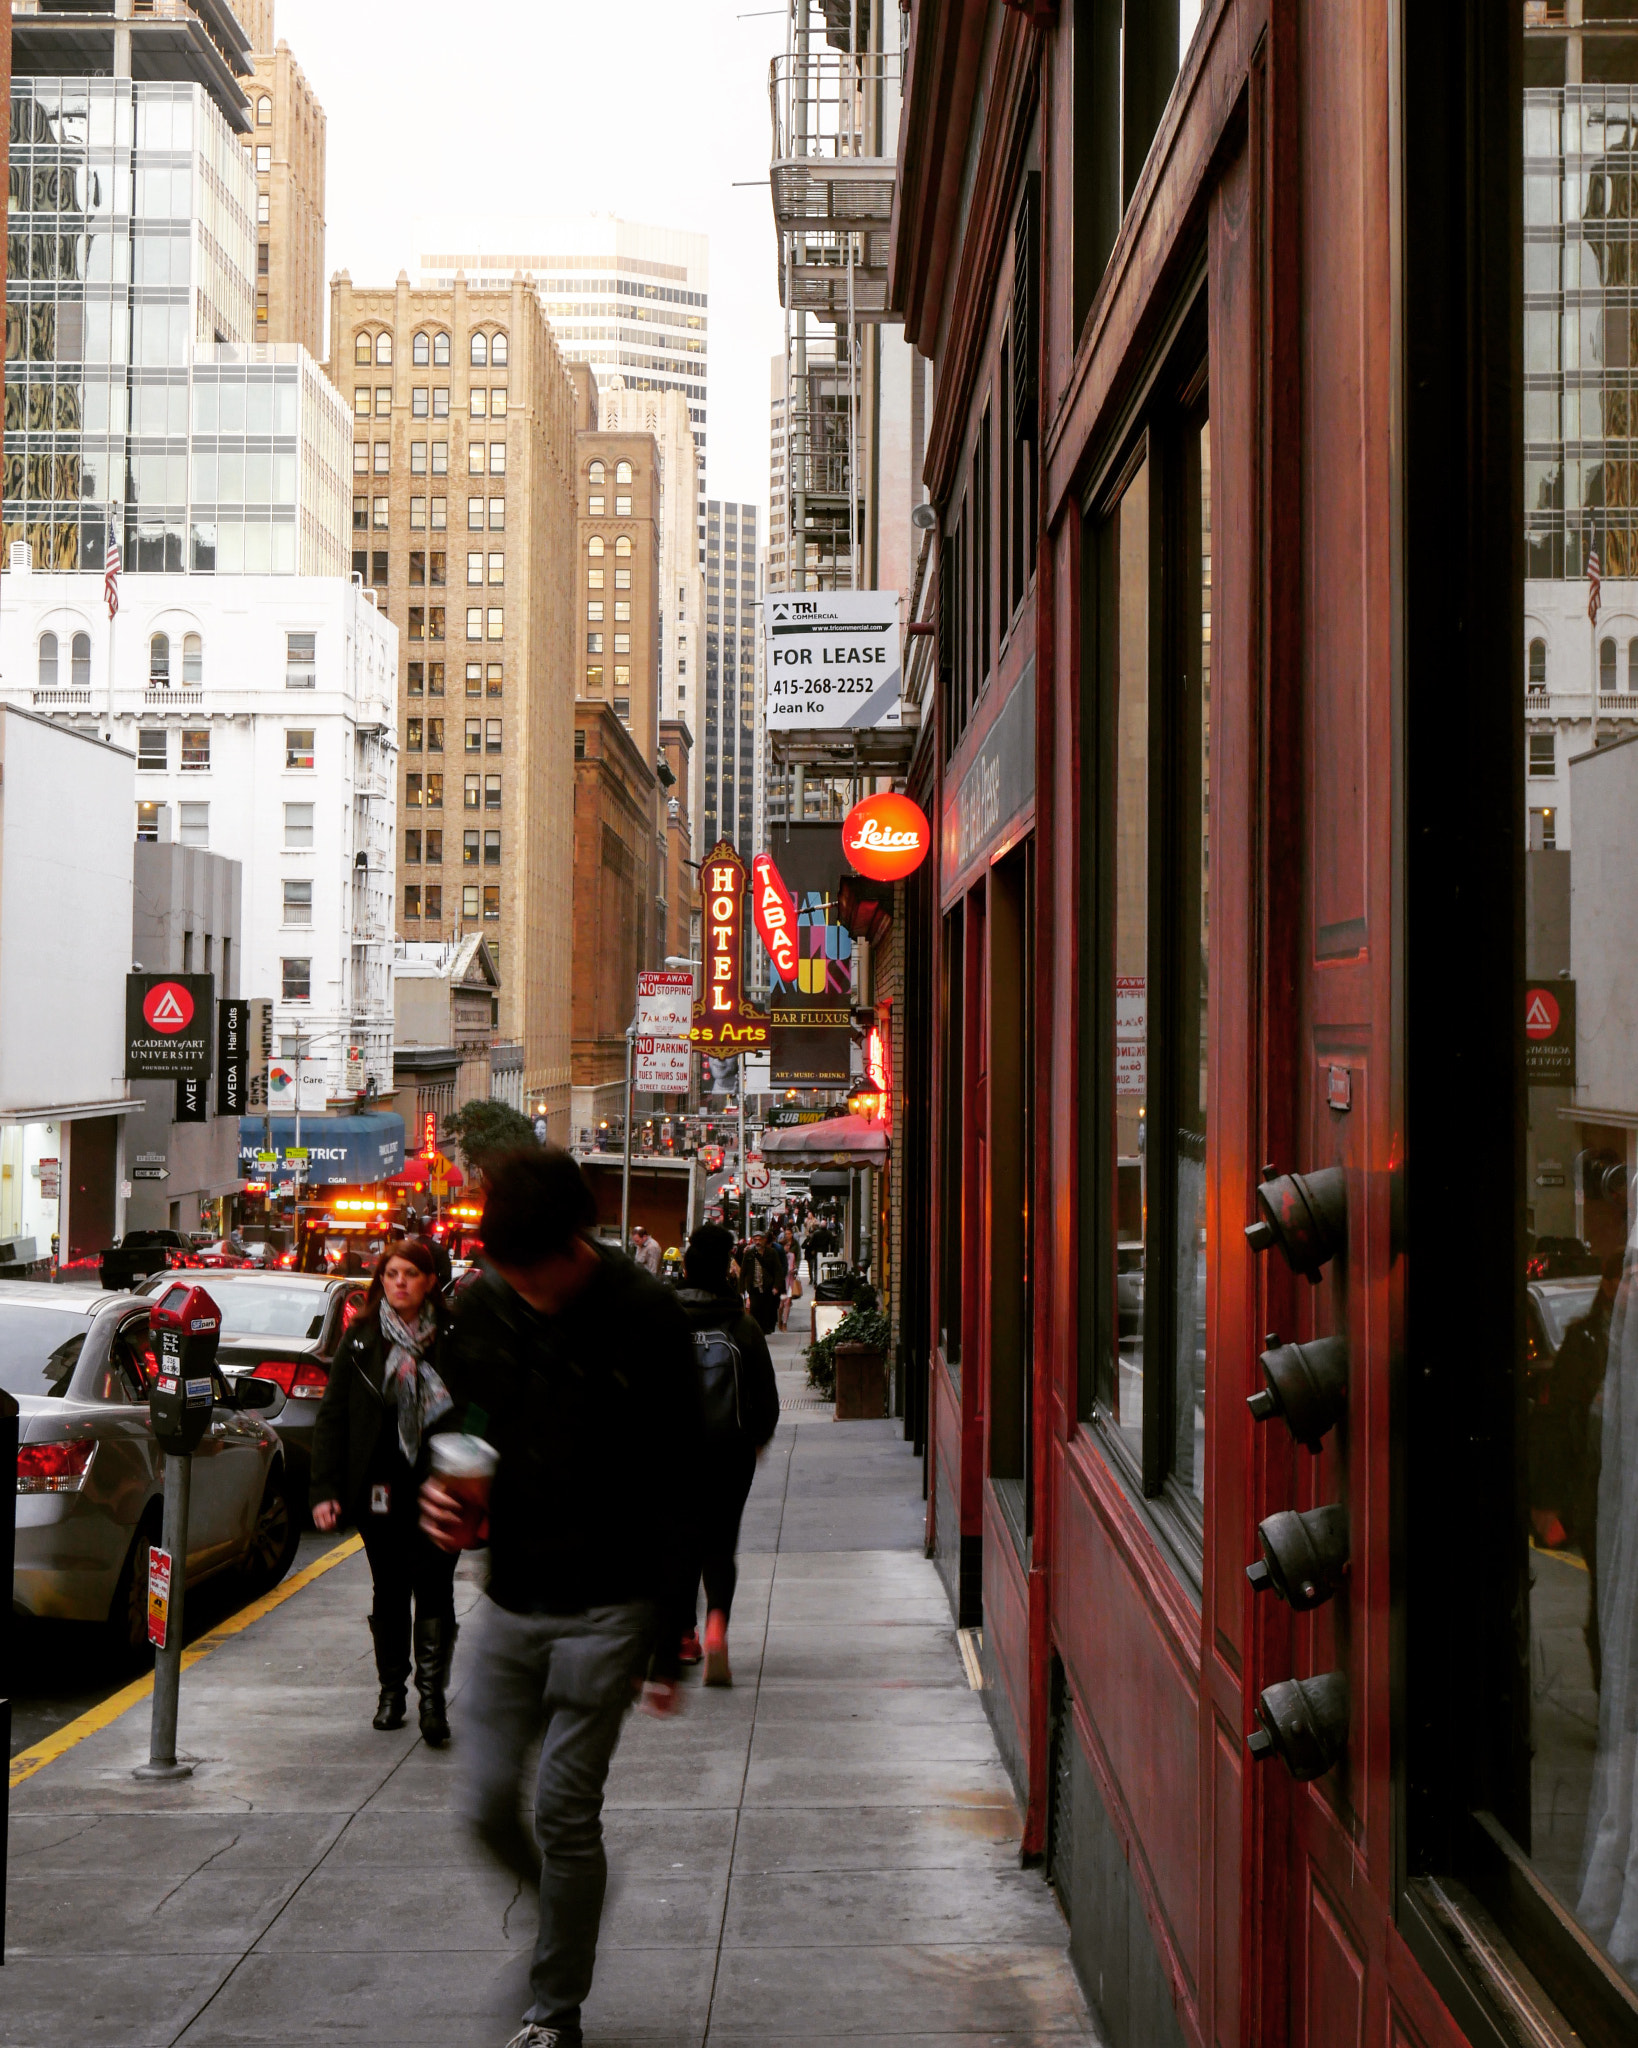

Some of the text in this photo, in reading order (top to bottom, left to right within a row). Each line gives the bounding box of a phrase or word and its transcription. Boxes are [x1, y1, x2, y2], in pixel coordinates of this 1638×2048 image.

[792, 602, 817, 614] TRI
[774, 648, 886, 666] FOR LEASE
[774, 678, 874, 695] 415-268-2252
[773, 701, 824, 714] Jean Ko
[850, 818, 920, 852] Leica
[757, 864, 794, 970] TABAC
[712, 868, 734, 1010] HOTEL
[639, 982, 692, 996] NO STOPPING
[773, 1013, 849, 1024] BAR FLUXUS
[720, 1023, 766, 1042] Arts
[131, 1040, 178, 1048] ACADEMY
[184, 1040, 206, 1048] ART
[638, 1038, 688, 1054] NO PARKING
[131, 1051, 204, 1059] UNIVERSITY
[228, 1007, 238, 1108] AVEDA Hair Cuts
[638, 1071, 688, 1080] TUES THURS SUN
[186, 1078, 196, 1112] AVE
[776, 1112, 826, 1124] SUBWAY
